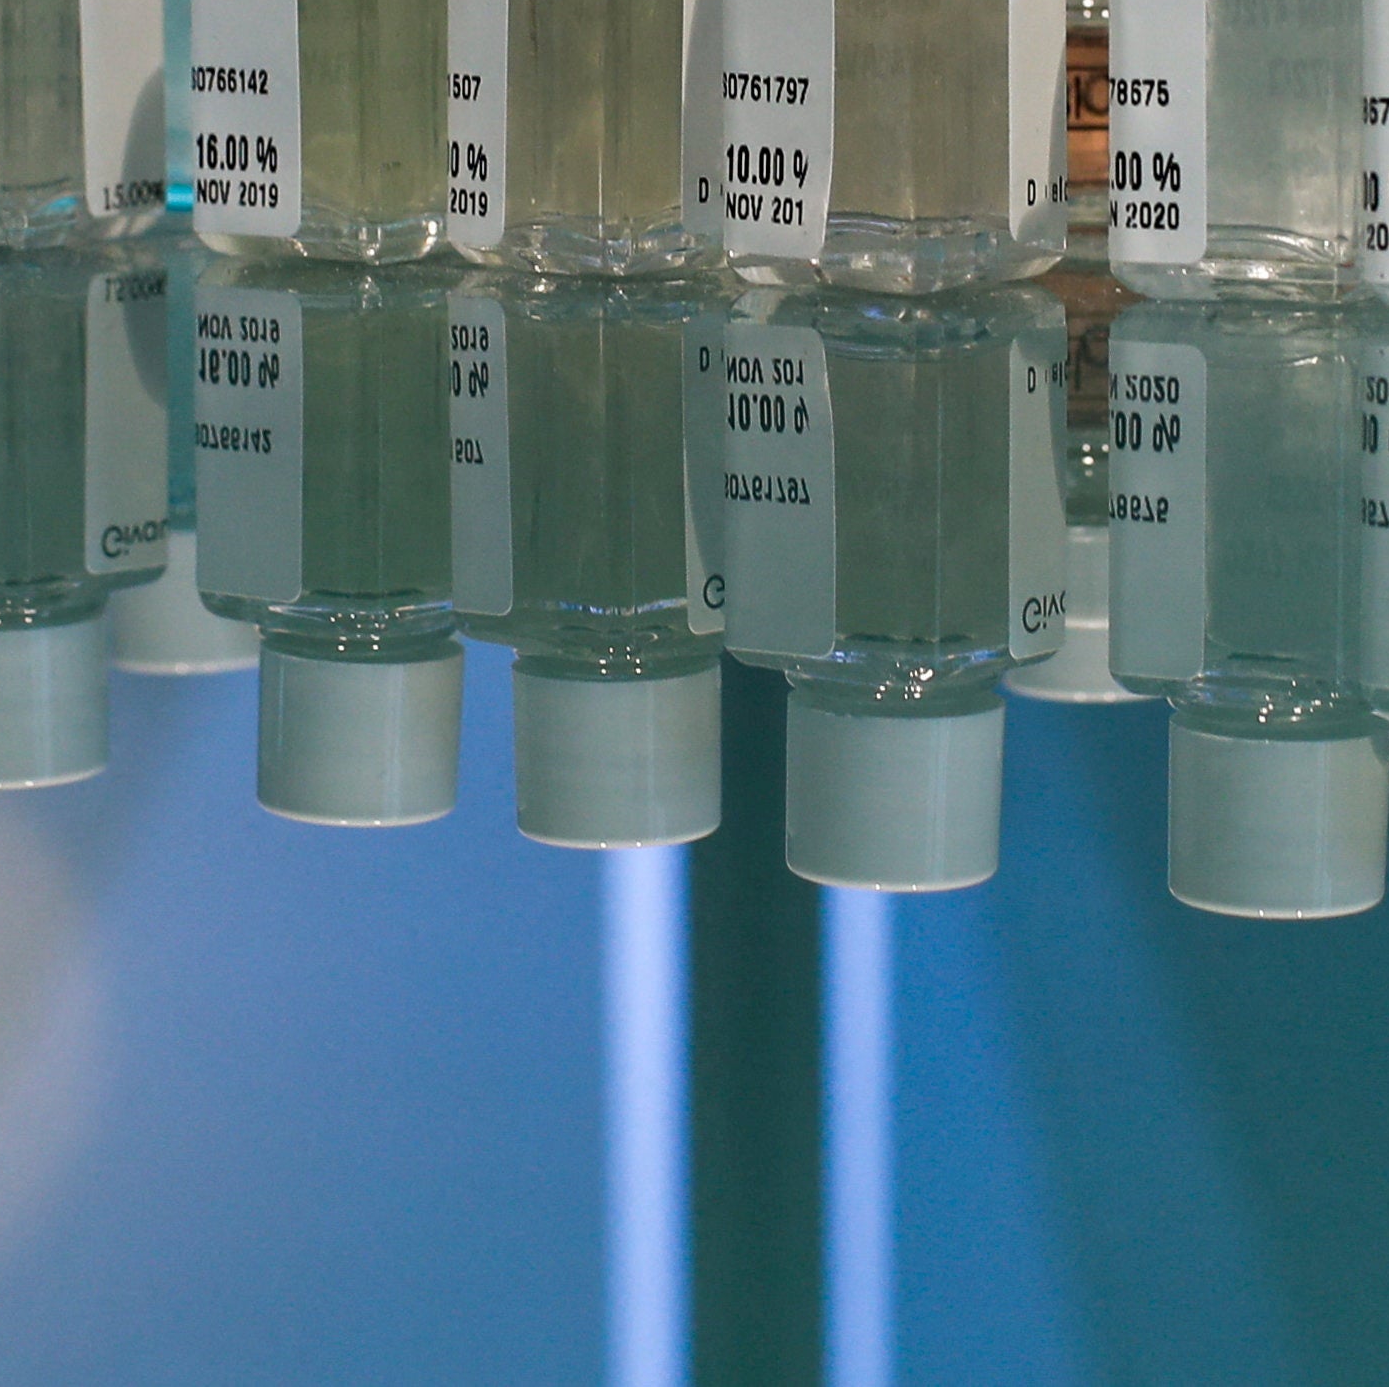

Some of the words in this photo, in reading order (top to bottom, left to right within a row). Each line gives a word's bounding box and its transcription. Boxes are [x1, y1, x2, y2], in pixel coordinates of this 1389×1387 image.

[197, 133, 249, 172] 16.00
[256, 136, 278, 173] %
[467, 143, 488, 181] %
[727, 143, 785, 187] 10.00
[1152, 152, 1181, 193] %
[197, 178, 230, 205] NOV
[239, 180, 279, 209] 2019
[450, 187, 488, 218] 2019
[726, 191, 763, 223] NOV
[772, 195, 804, 226] 201
[1125, 202, 1180, 230] 2020
